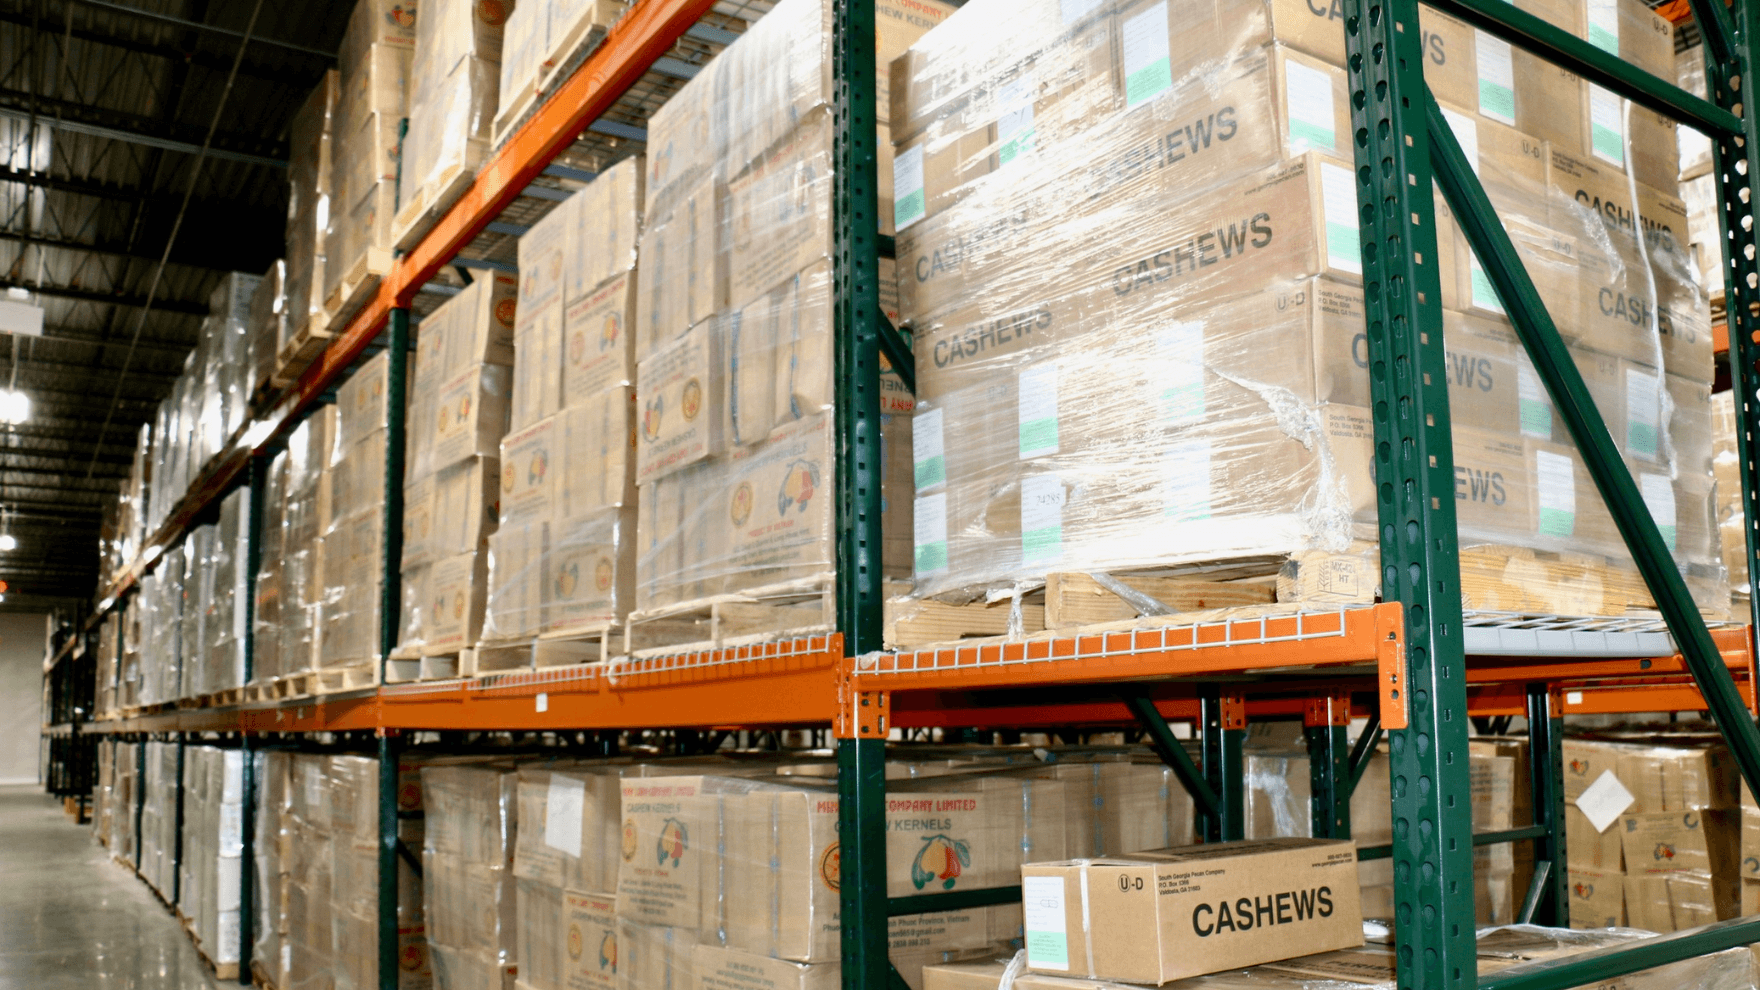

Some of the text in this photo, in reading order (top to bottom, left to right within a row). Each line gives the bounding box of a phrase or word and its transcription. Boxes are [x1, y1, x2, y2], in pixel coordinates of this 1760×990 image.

[1112, 212, 1273, 297] CASHEWS
[934, 304, 1052, 369] CASHEWS
[1339, 574, 1349, 583] HT
[936, 799, 977, 812] LIMITED
[895, 819, 952, 831] KERNELS
[1118, 874, 1144, 892] U-D
[1173, 872, 1190, 880] Georgia
[1192, 886, 1334, 937] CASHEWS
